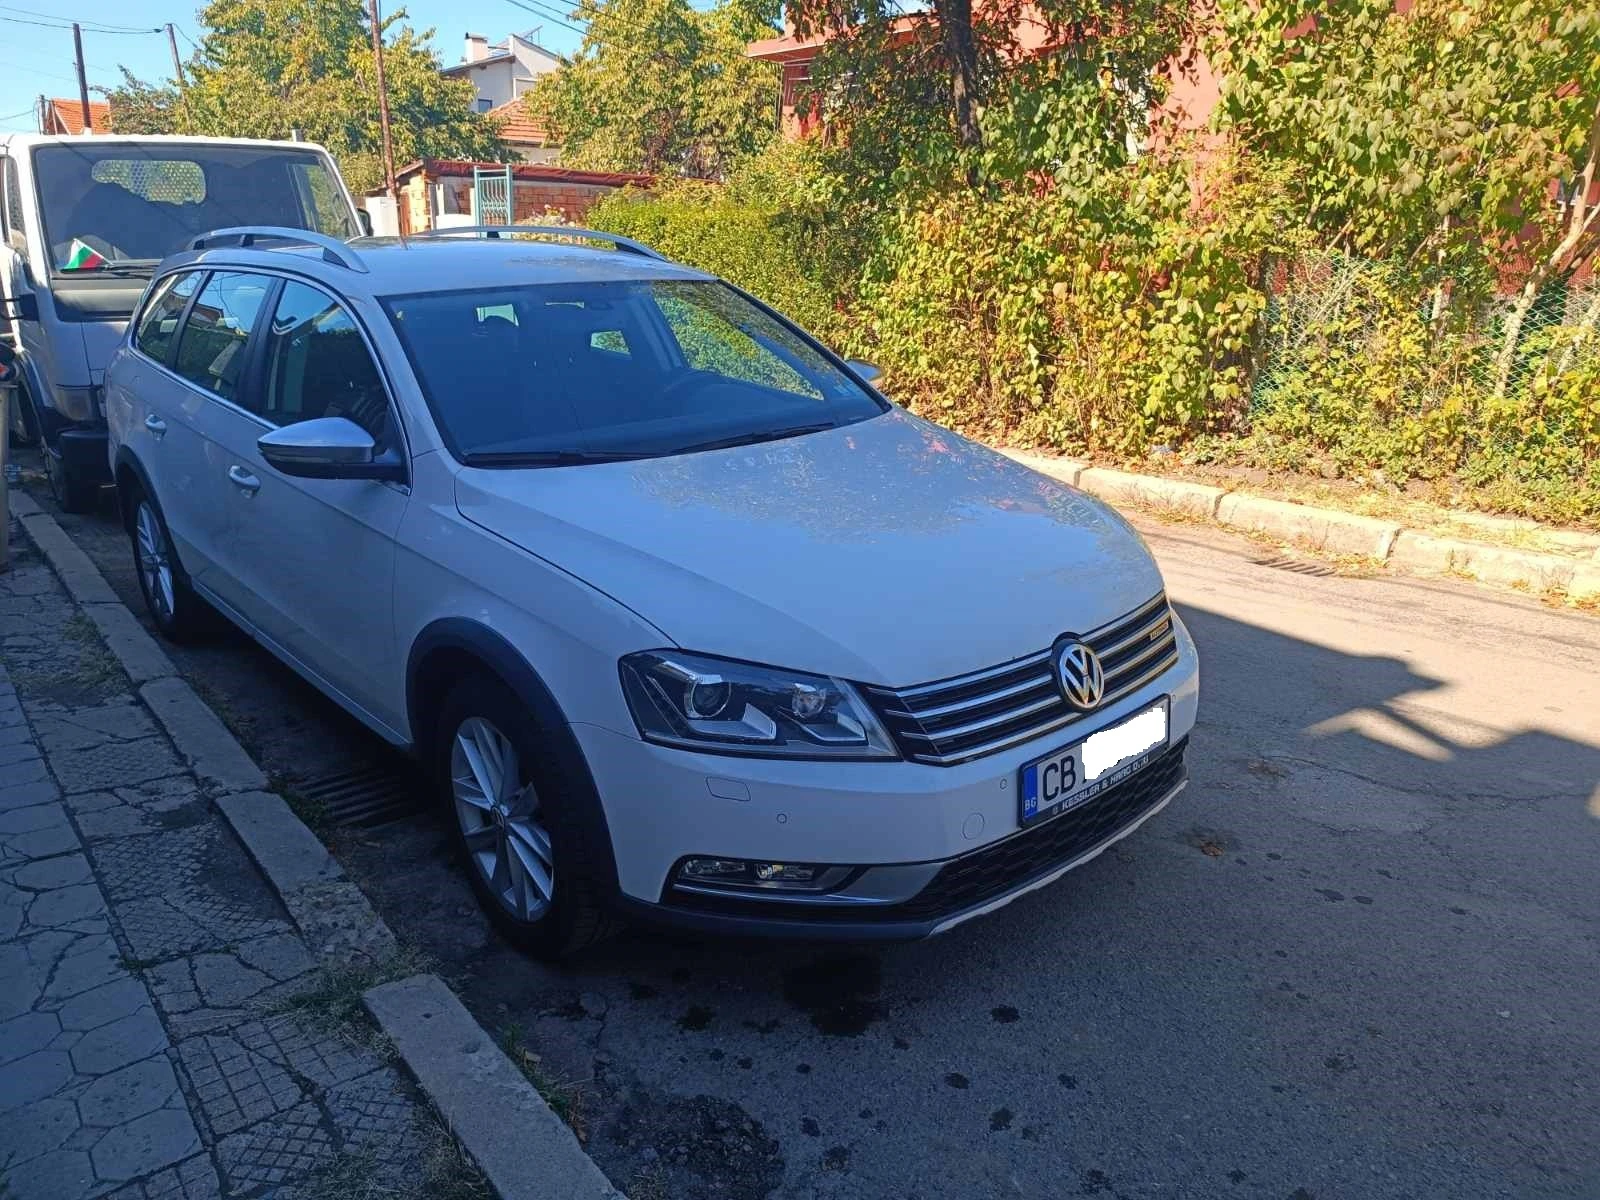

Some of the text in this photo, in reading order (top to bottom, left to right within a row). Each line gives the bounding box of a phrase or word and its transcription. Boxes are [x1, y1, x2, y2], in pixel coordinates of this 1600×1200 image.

[1042, 755, 1077, 802] CB
[1024, 796, 1037, 811] BG
[1062, 784, 1100, 811] KESSLER
